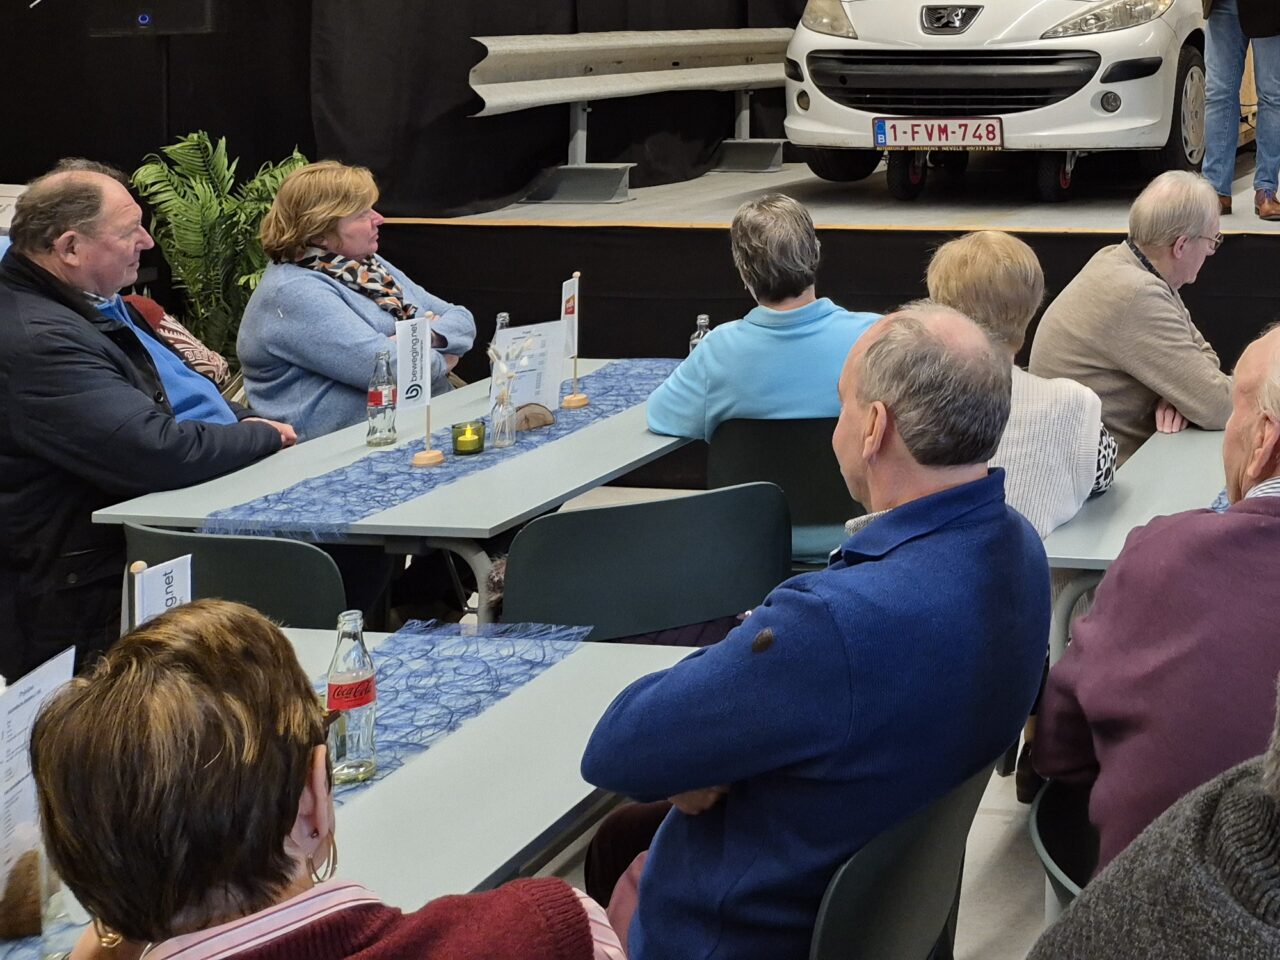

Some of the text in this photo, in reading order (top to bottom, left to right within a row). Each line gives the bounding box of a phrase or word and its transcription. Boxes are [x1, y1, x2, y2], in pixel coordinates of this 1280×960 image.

[877, 123, 996, 144] B 1-FVM-748
[410, 323, 420, 382] beweging.net
